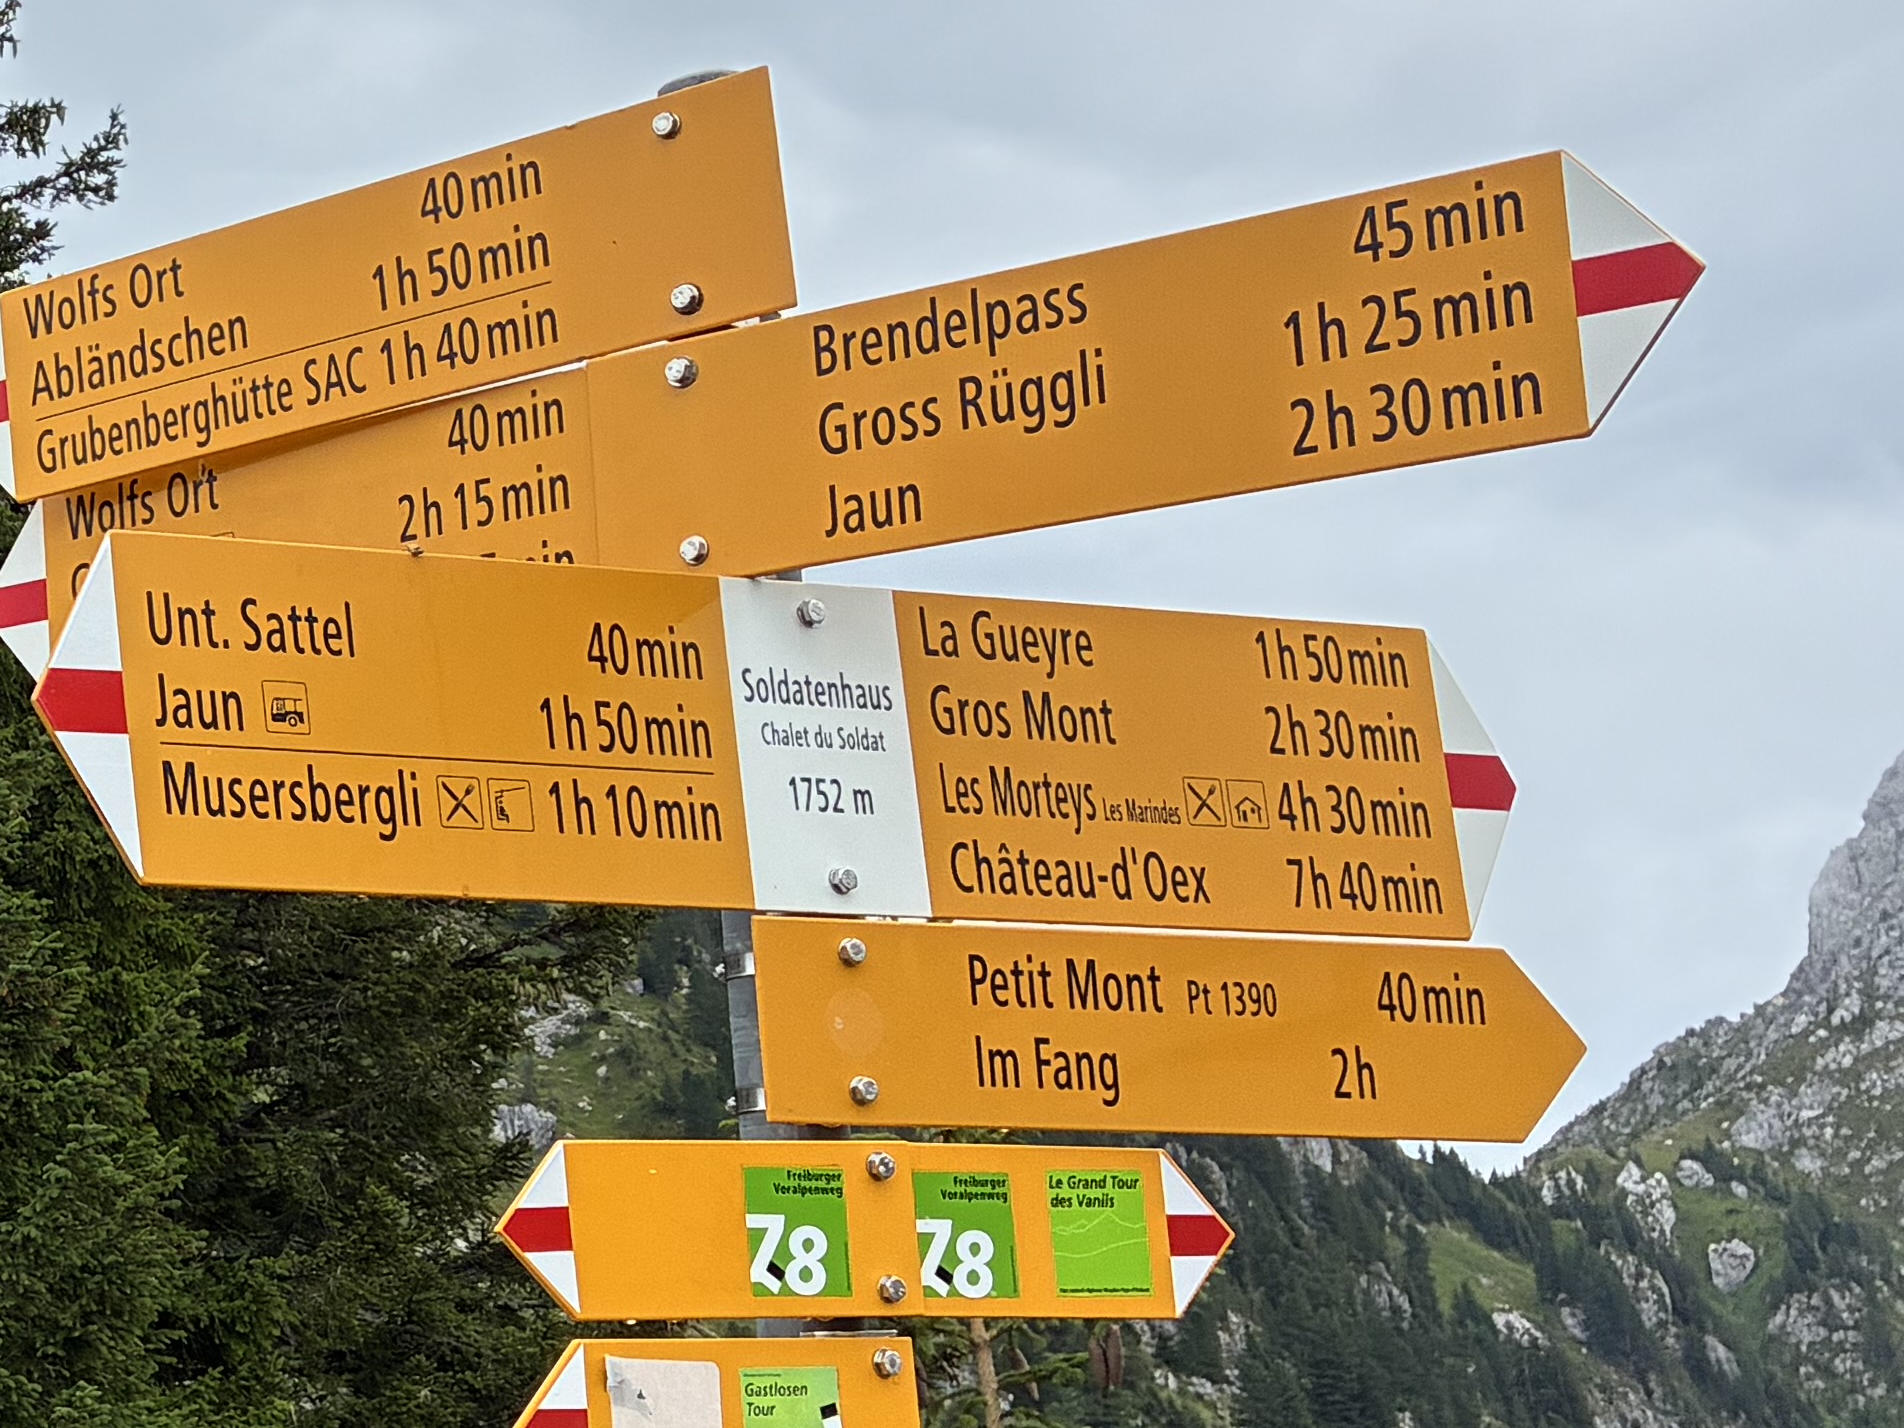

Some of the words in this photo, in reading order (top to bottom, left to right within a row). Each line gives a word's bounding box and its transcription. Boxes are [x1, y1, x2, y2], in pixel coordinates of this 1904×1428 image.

[24, 280, 118, 340] Wolfs
[129, 257, 185, 309] Ort
[31, 315, 248, 407] Abländschen
[813, 282, 1088, 379] Brendelpass
[36, 374, 293, 474] Grubenberghütte
[303, 346, 367, 406] SAC
[818, 396, 941, 455] Gross
[958, 347, 1106, 434] Rüggli
[65, 477, 155, 540] Wolfs
[166, 463, 219, 518] Ort
[825, 483, 922, 538] Jaun
[146, 590, 230, 650] Unt.
[240, 597, 355, 658] Sattel
[918, 605, 960, 658] La
[971, 610, 1094, 680] Gueyre
[155, 672, 245, 732] Jaun
[741, 666, 893, 712] Soldatenhaus
[930, 684, 1012, 739] Gros
[1022, 689, 1117, 745] Mont
[760, 720, 811, 748] Chalet
[814, 724, 834, 749] du
[836, 726, 887, 753] Soldat
[161, 760, 422, 842] Musersbergli
[788, 776, 845, 814] 1752
[852, 788, 875, 815] m
[939, 762, 984, 815] Les
[988, 765, 1097, 835] Morteys
[1102, 796, 1124, 822] Les
[950, 838, 1211, 904] Château-d'Oex
[968, 953, 1054, 1009] Petit
[1065, 958, 1164, 1014] Mont
[1186, 979, 1213, 1015] Pt
[1220, 981, 1277, 1018] 1390
[975, 1034, 1021, 1089] Im
[1034, 1037, 1120, 1108] Fang
[773, 1182, 843, 1198] Voralpenweg
[786, 1169, 842, 1185] Freiburger
[940, 1189, 1008, 1204] Voralpenweg
[953, 1175, 1007, 1191] Freiburger
[1048, 1174, 1064, 1190] Le
[1067, 1174, 1107, 1190] Grand
[1110, 1175, 1140, 1190] Tour
[1050, 1193, 1073, 1208] des
[1076, 1193, 1115, 1208] Vanils
[744, 1382, 808, 1398] Gastlosen
[746, 1402, 776, 1417] Tour
